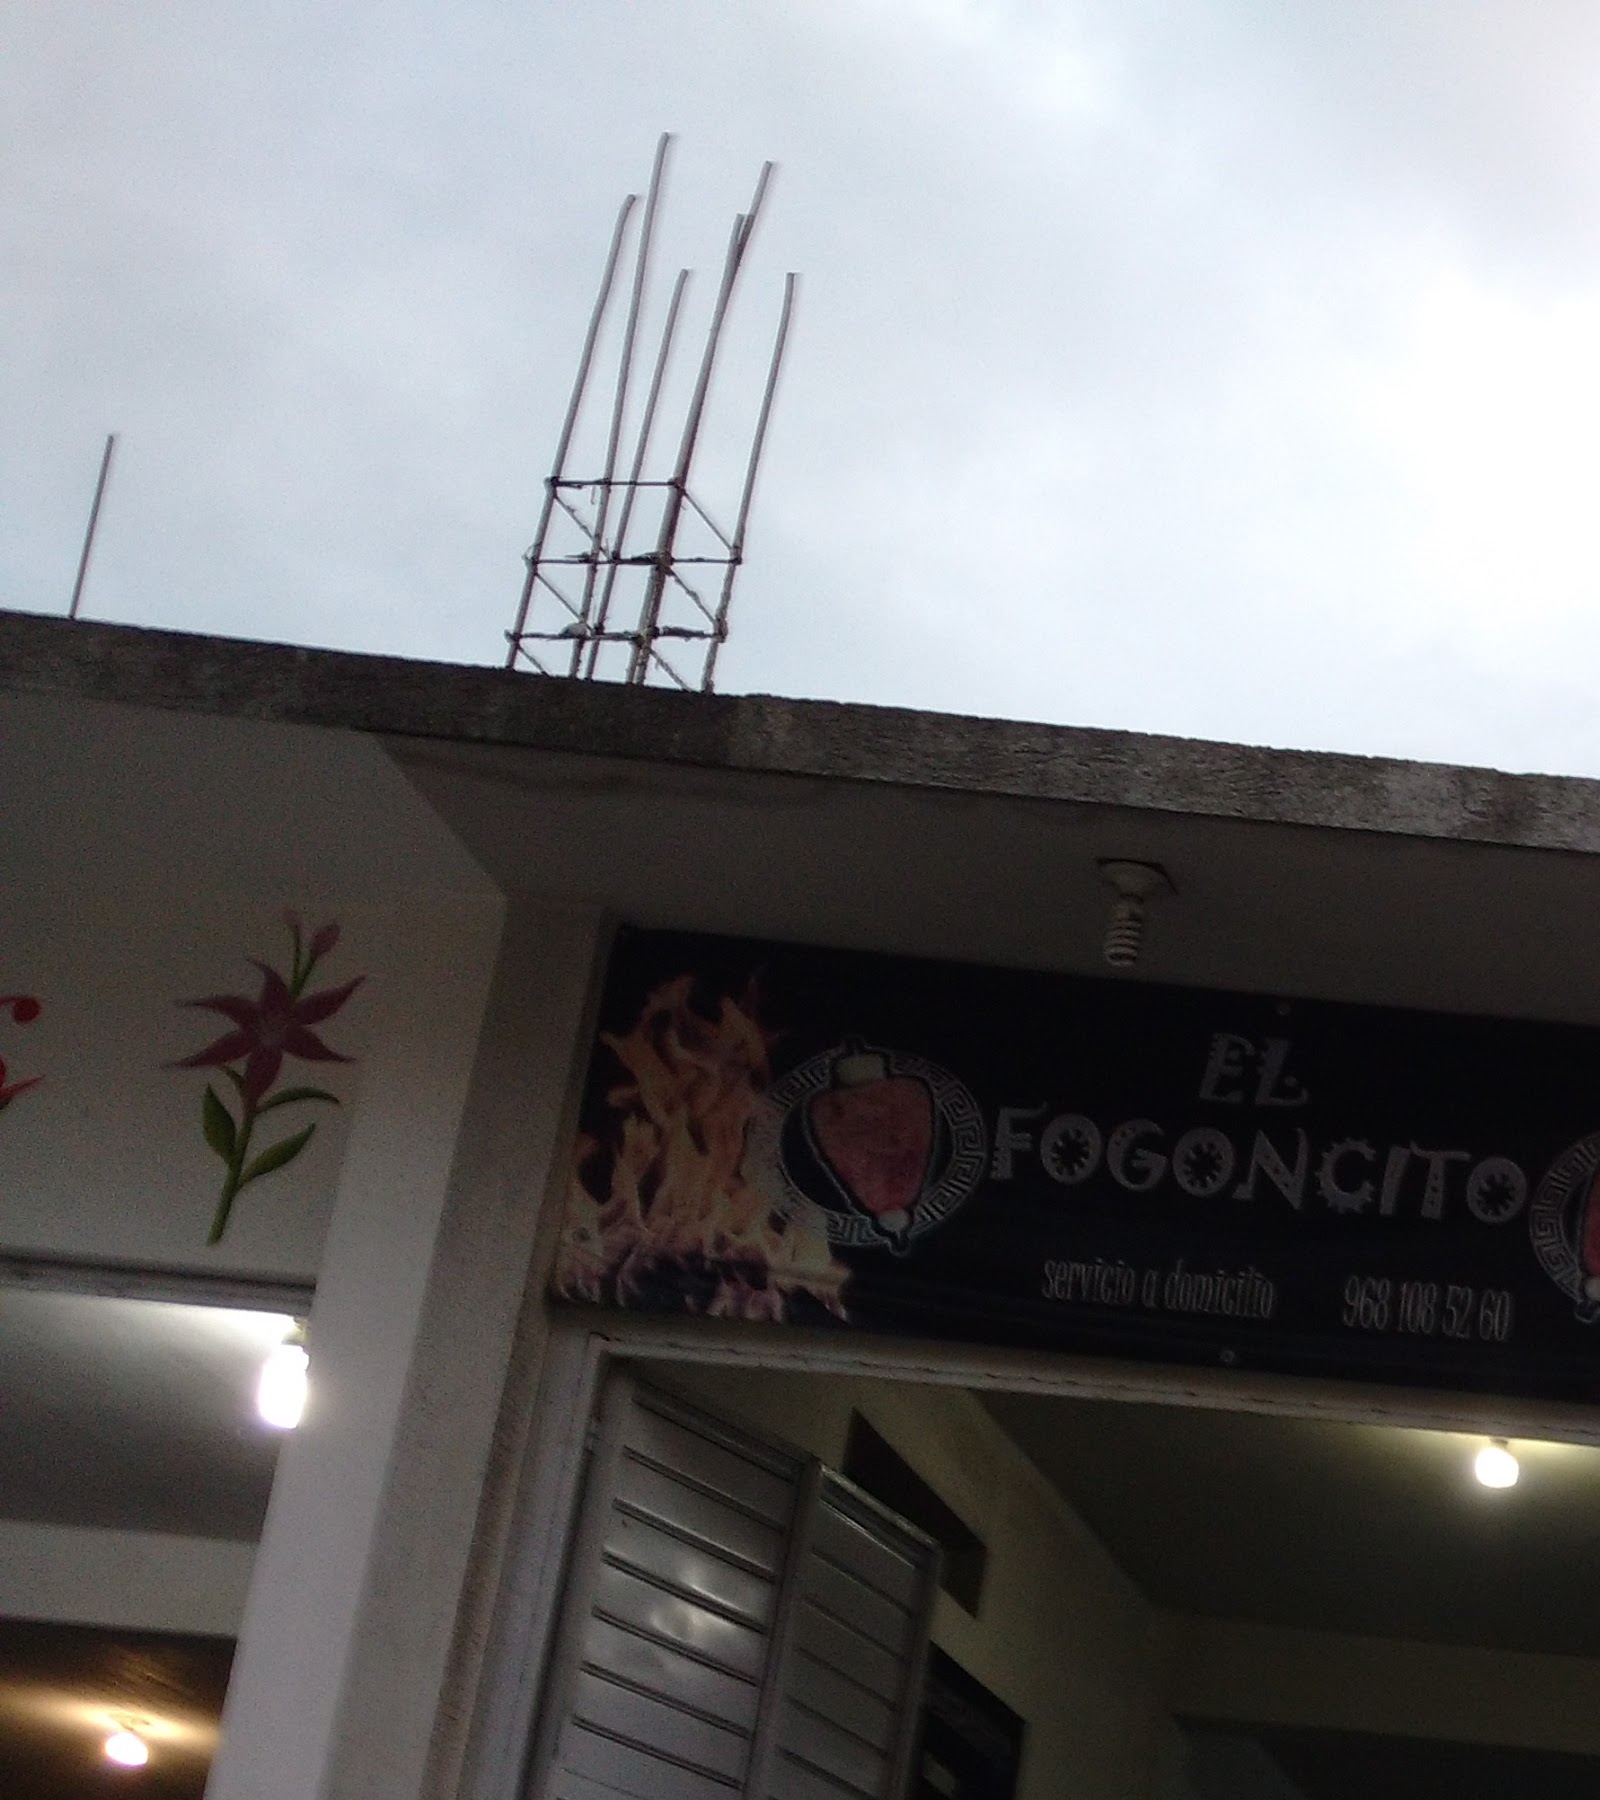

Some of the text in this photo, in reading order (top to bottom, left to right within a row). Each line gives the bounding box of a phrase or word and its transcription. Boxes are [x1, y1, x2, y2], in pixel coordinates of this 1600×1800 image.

[1200, 1032, 1309, 1107] EL
[990, 1100, 1527, 1224] FOGONCITO
[1041, 1257, 1274, 1319] servicio a domicilio
[1343, 1275, 1511, 1341] 968 108 52 60
